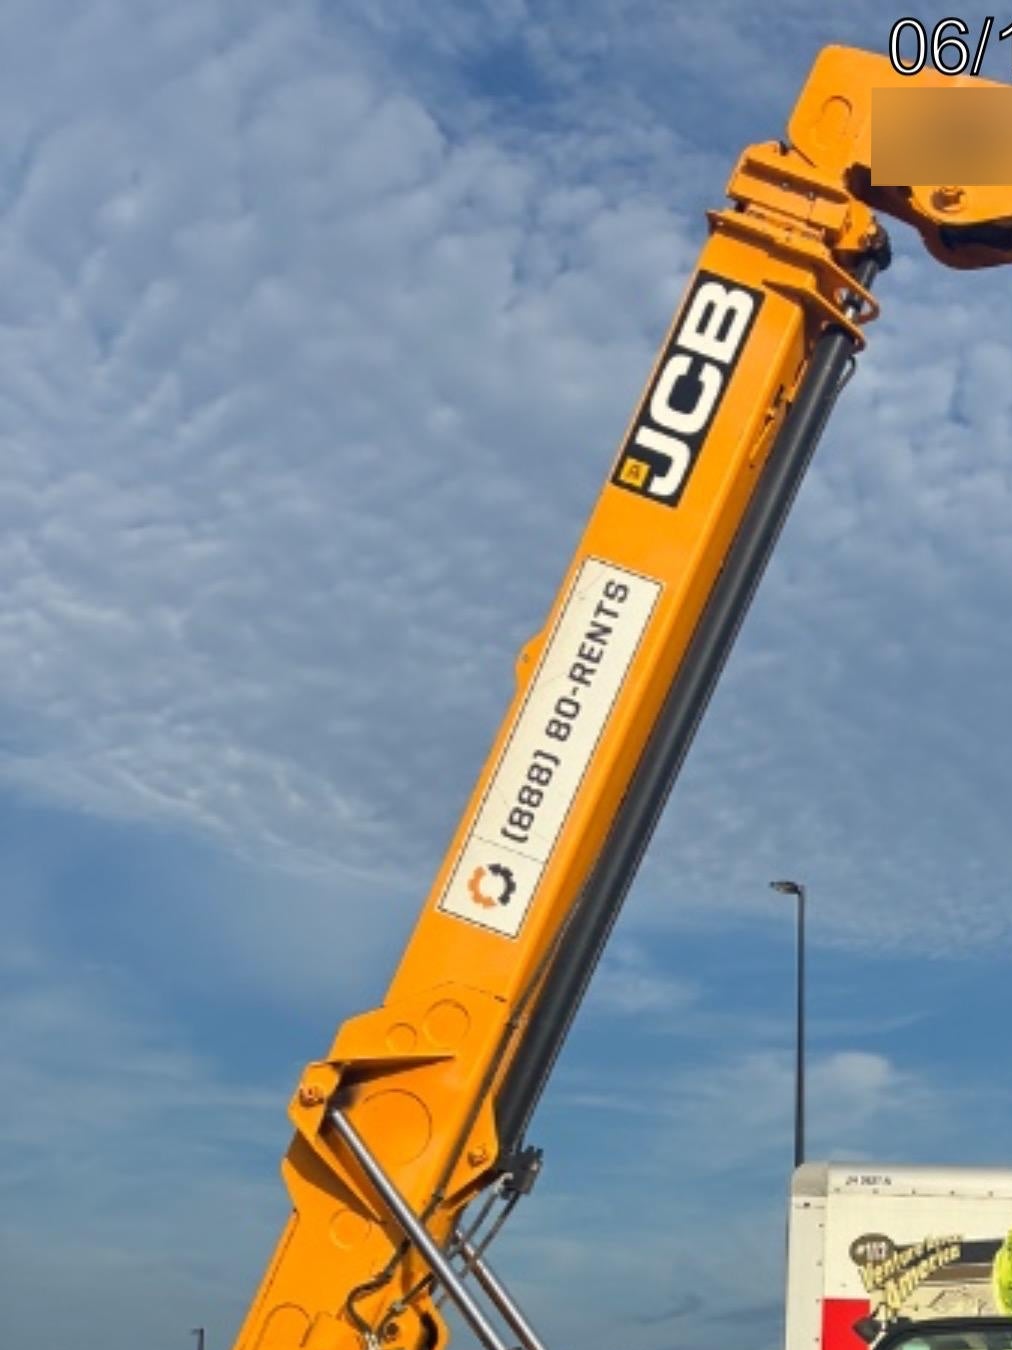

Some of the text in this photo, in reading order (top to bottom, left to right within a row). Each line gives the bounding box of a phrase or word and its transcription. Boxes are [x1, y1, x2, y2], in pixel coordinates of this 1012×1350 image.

[633, 281, 755, 497] JCB
[500, 578, 631, 844] (888) 80-RENTS
